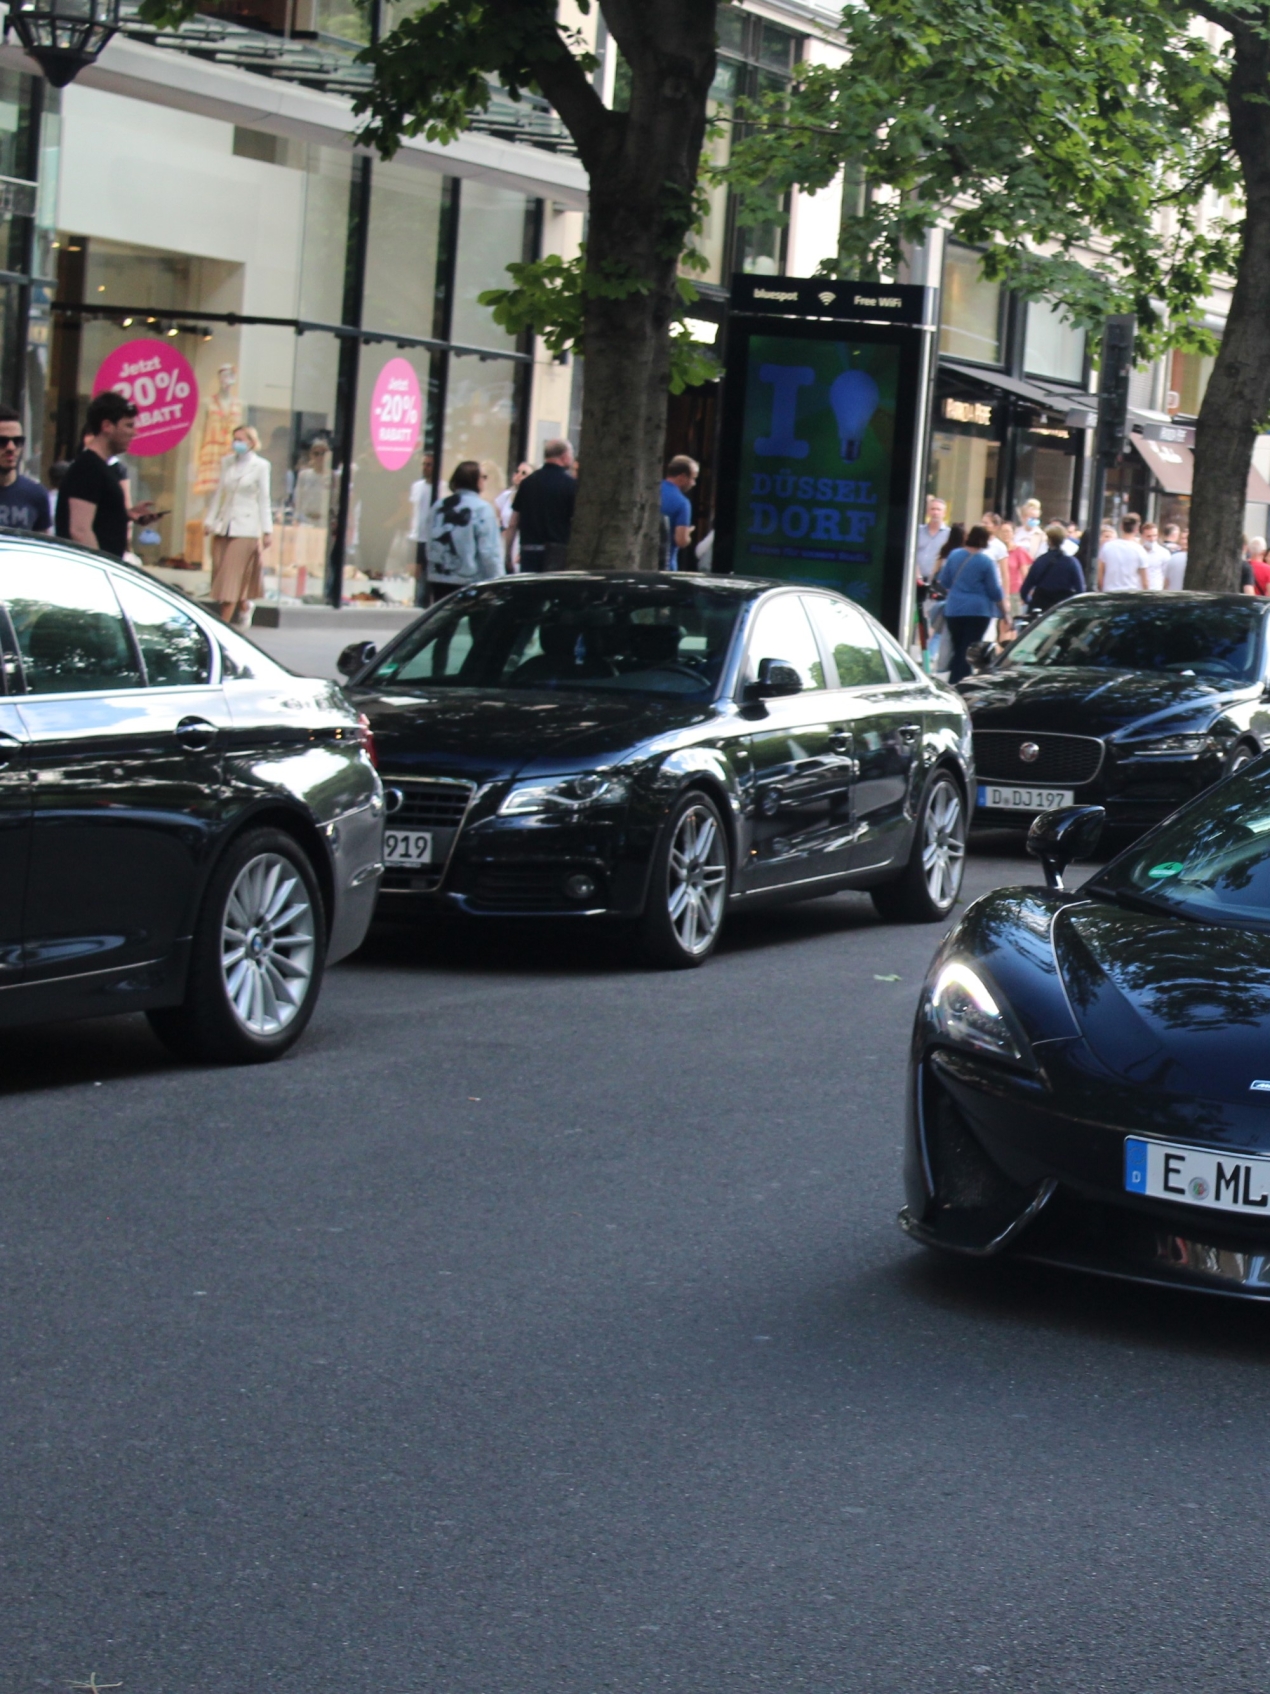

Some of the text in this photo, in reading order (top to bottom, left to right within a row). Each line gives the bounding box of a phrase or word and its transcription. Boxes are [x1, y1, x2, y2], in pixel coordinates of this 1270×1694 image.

[753, 288, 902, 308] bluespot Free WiFi
[119, 355, 162, 378] Jetzt
[374, 393, 418, 424] -20%
[754, 363, 815, 459] I
[751, 468, 878, 504] DÜSSEL
[748, 502, 876, 543] DORF
[992, 788, 1065, 808] D DJ 197
[385, 834, 428, 859] 919
[1163, 1152, 1186, 1195] E
[1214, 1161, 1269, 1208] ML
